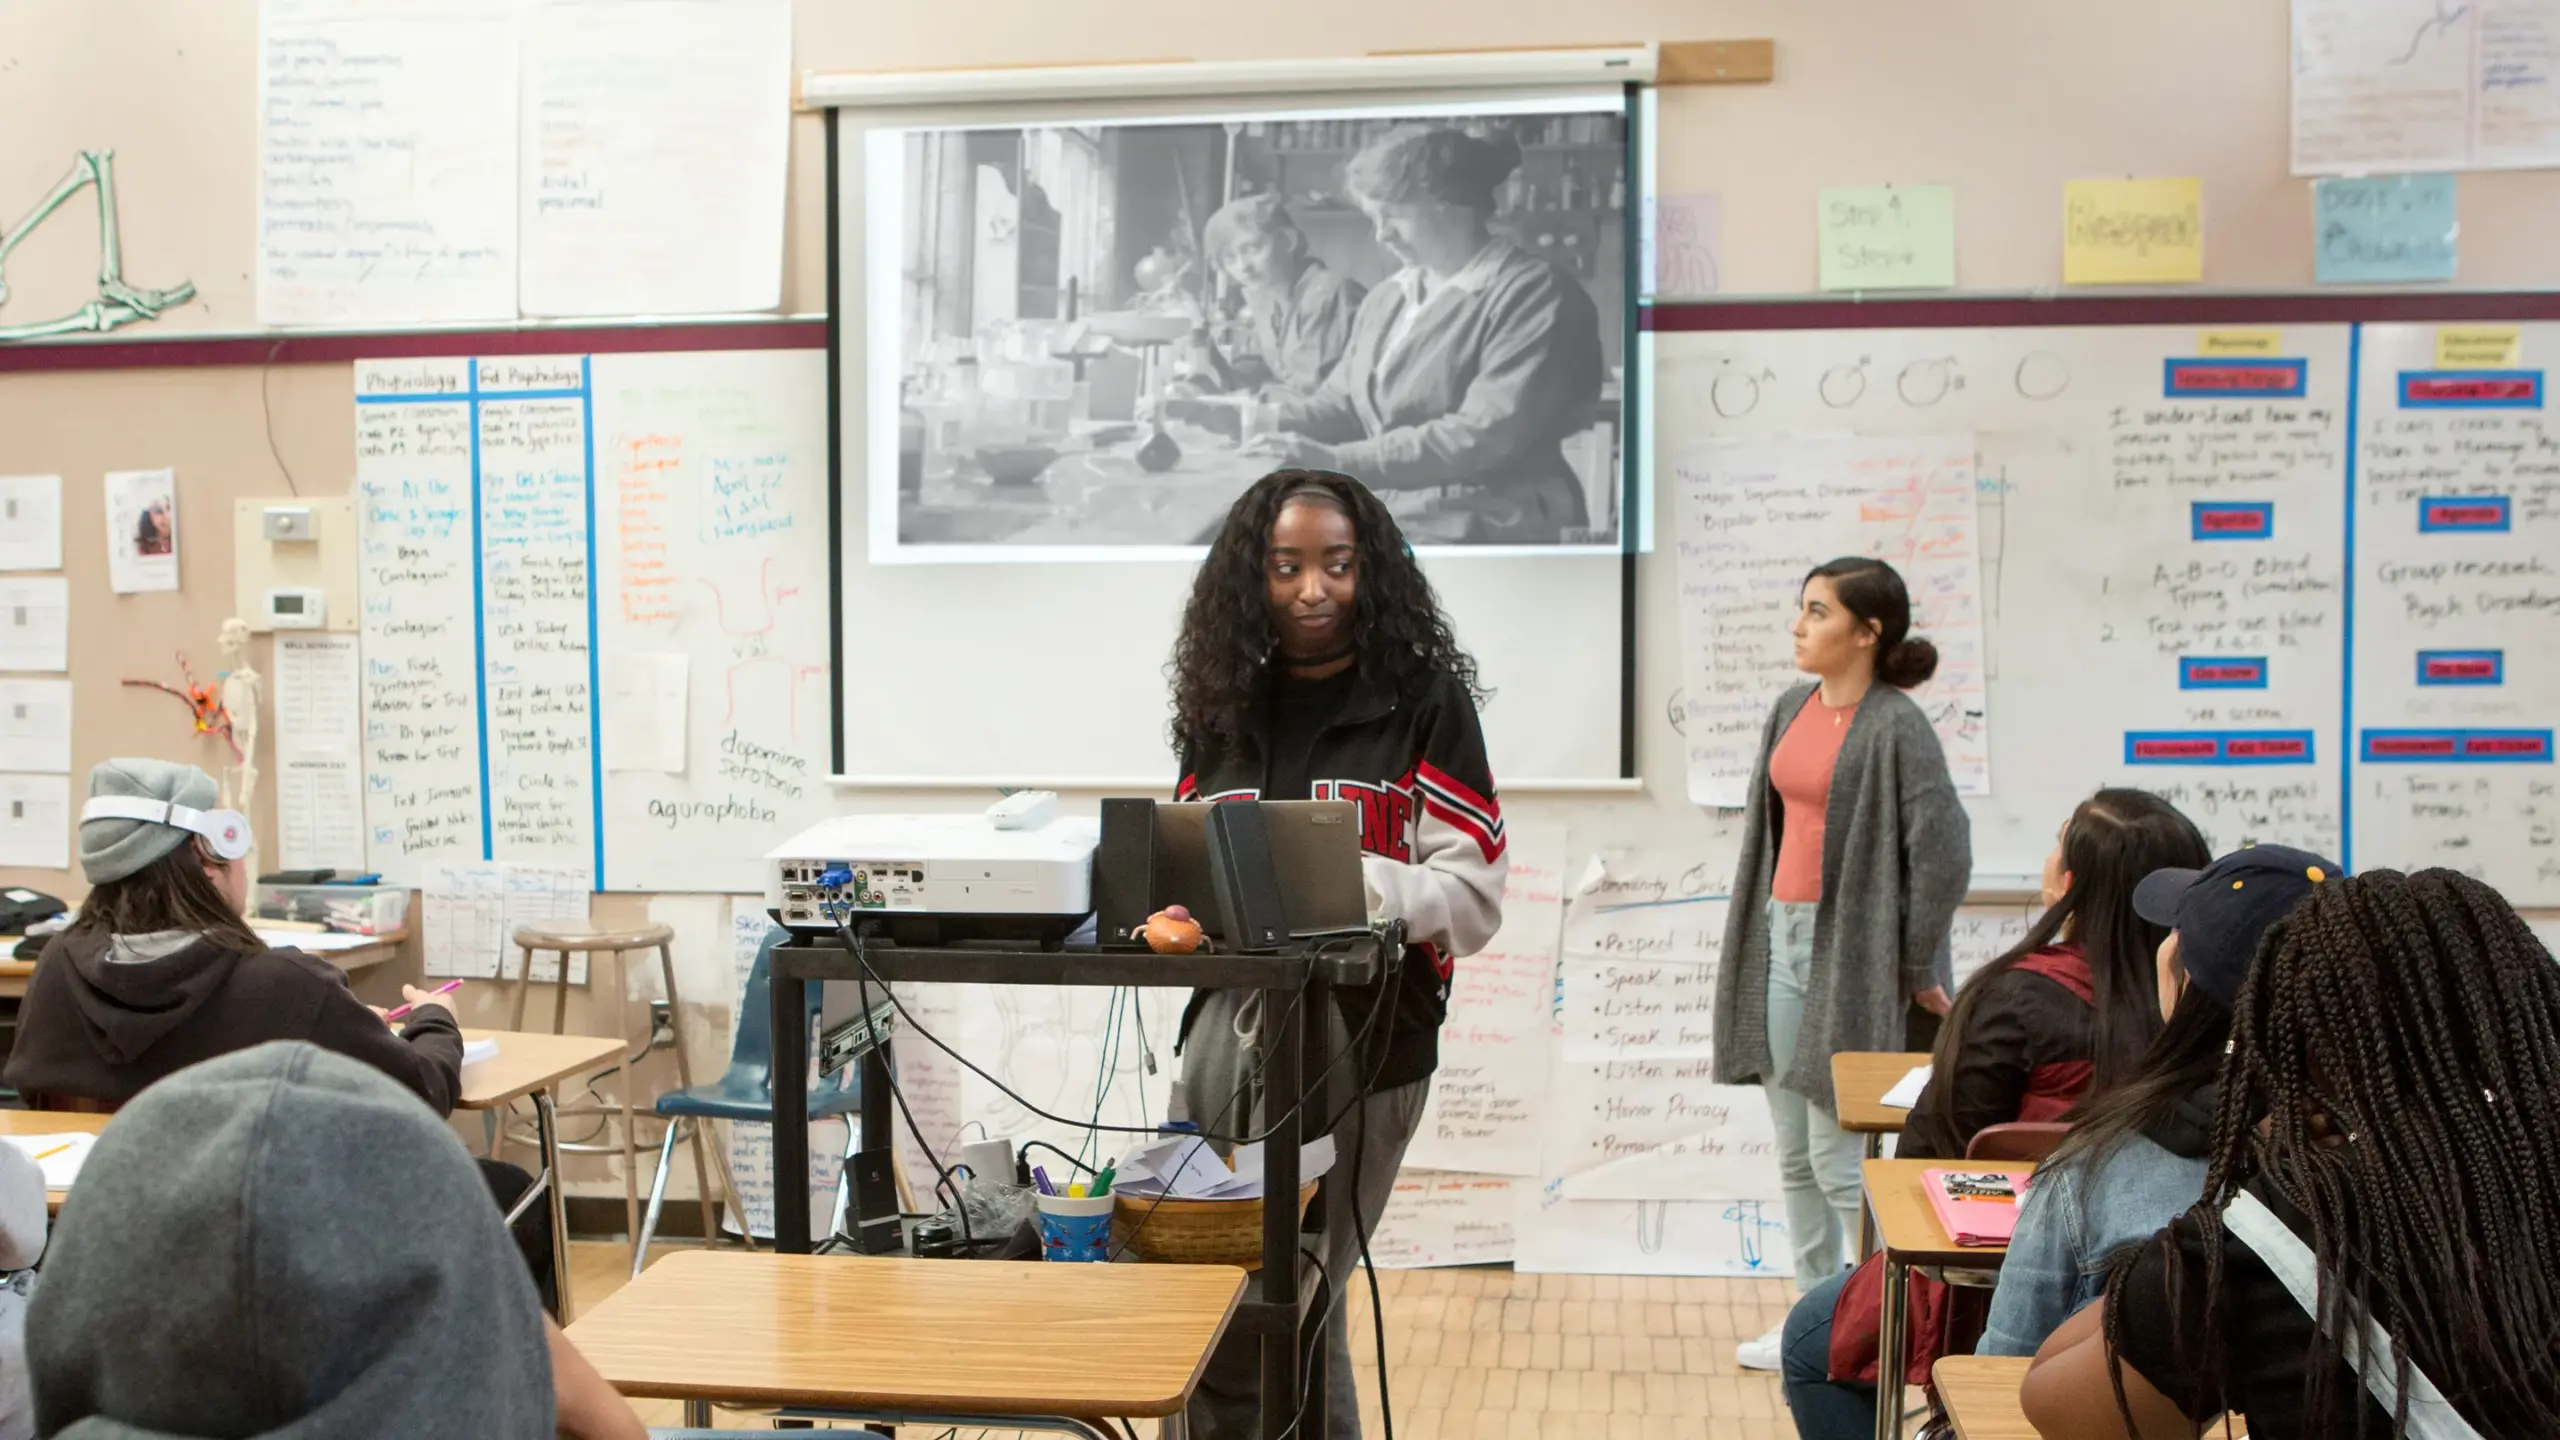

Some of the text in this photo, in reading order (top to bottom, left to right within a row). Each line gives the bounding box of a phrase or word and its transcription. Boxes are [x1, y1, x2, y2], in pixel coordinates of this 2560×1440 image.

[366, 366, 457, 394] Physiology
[2144, 405, 2252, 425] understand
[721, 728, 808, 777] dopamine
[1605, 930, 1674, 956] Respect
[1604, 965, 1715, 992] Speak with
[1604, 998, 1662, 1017] Listen
[1605, 1026, 1662, 1052] Speak
[1605, 1056, 1663, 1080] Listen
[1605, 1093, 1730, 1125] Honor Privacy
[1603, 1132, 1663, 1158] Remain
[1740, 1140, 1776, 1157] circ
